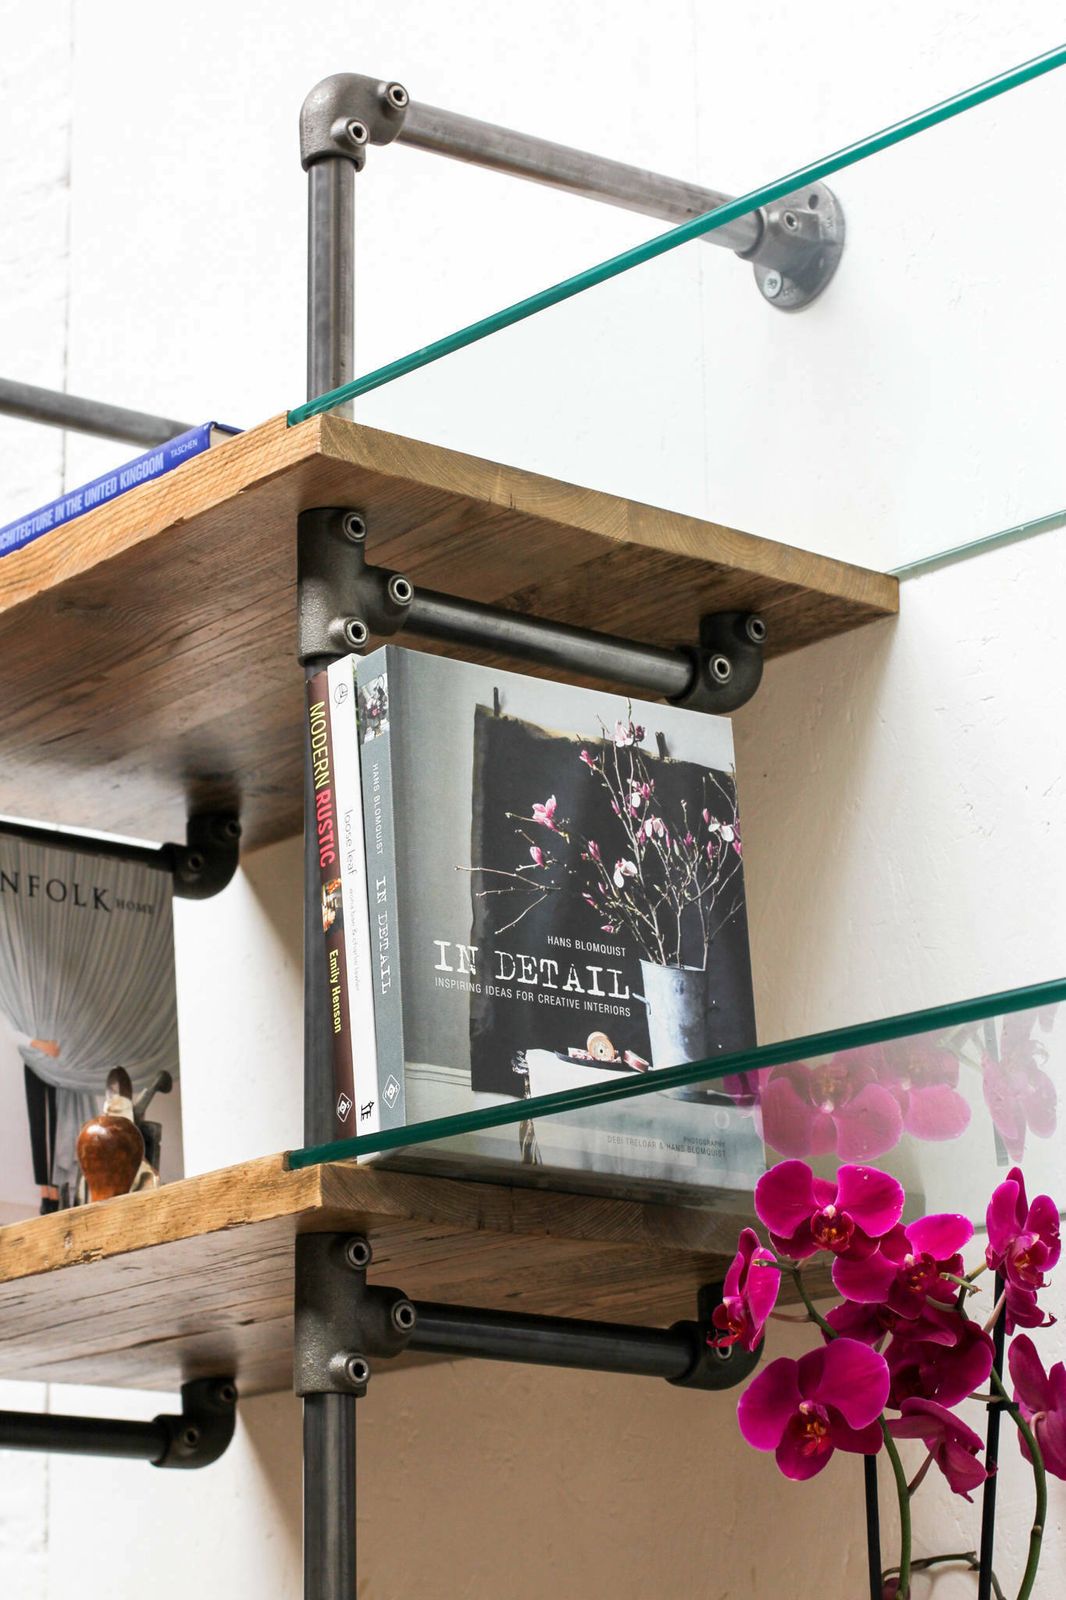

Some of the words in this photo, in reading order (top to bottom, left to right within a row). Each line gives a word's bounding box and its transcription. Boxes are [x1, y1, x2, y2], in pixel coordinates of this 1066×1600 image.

[169, 438, 198, 458] TASCHEN
[0, 509, 53, 549] CHITECTURE
[55, 502, 65, 523] IN
[65, 496, 83, 518] THE
[84, 477, 118, 507] UNITED
[119, 452, 164, 490] KINGDOM
[310, 700, 330, 790] MODERN
[372, 763, 380, 791] HANS
[316, 789, 336, 868] RUSTIC
[344, 809, 355, 847] loose
[373, 793, 385, 856] BLOMQUIST
[345, 847, 358, 875] leaf
[116, 898, 155, 914] HOME
[375, 875, 387, 904] IN
[378, 911, 392, 995] DETAIL
[547, 935, 572, 948] HANS
[575, 939, 627, 957] BLOMQUIST
[329, 949, 340, 984] Emily
[433, 939, 479, 975] IN
[494, 950, 630, 1000] DETAIL
[329, 984, 342, 1034] Henson
[434, 976, 482, 994] INSPIRING
[485, 984, 513, 999] IDEAS
[516, 990, 534, 1002] FOR
[537, 993, 581, 1010] CREATIVE
[583, 1001, 631, 1017] INTERIORS
[687, 1145, 726, 1158] BLOMQUIST
